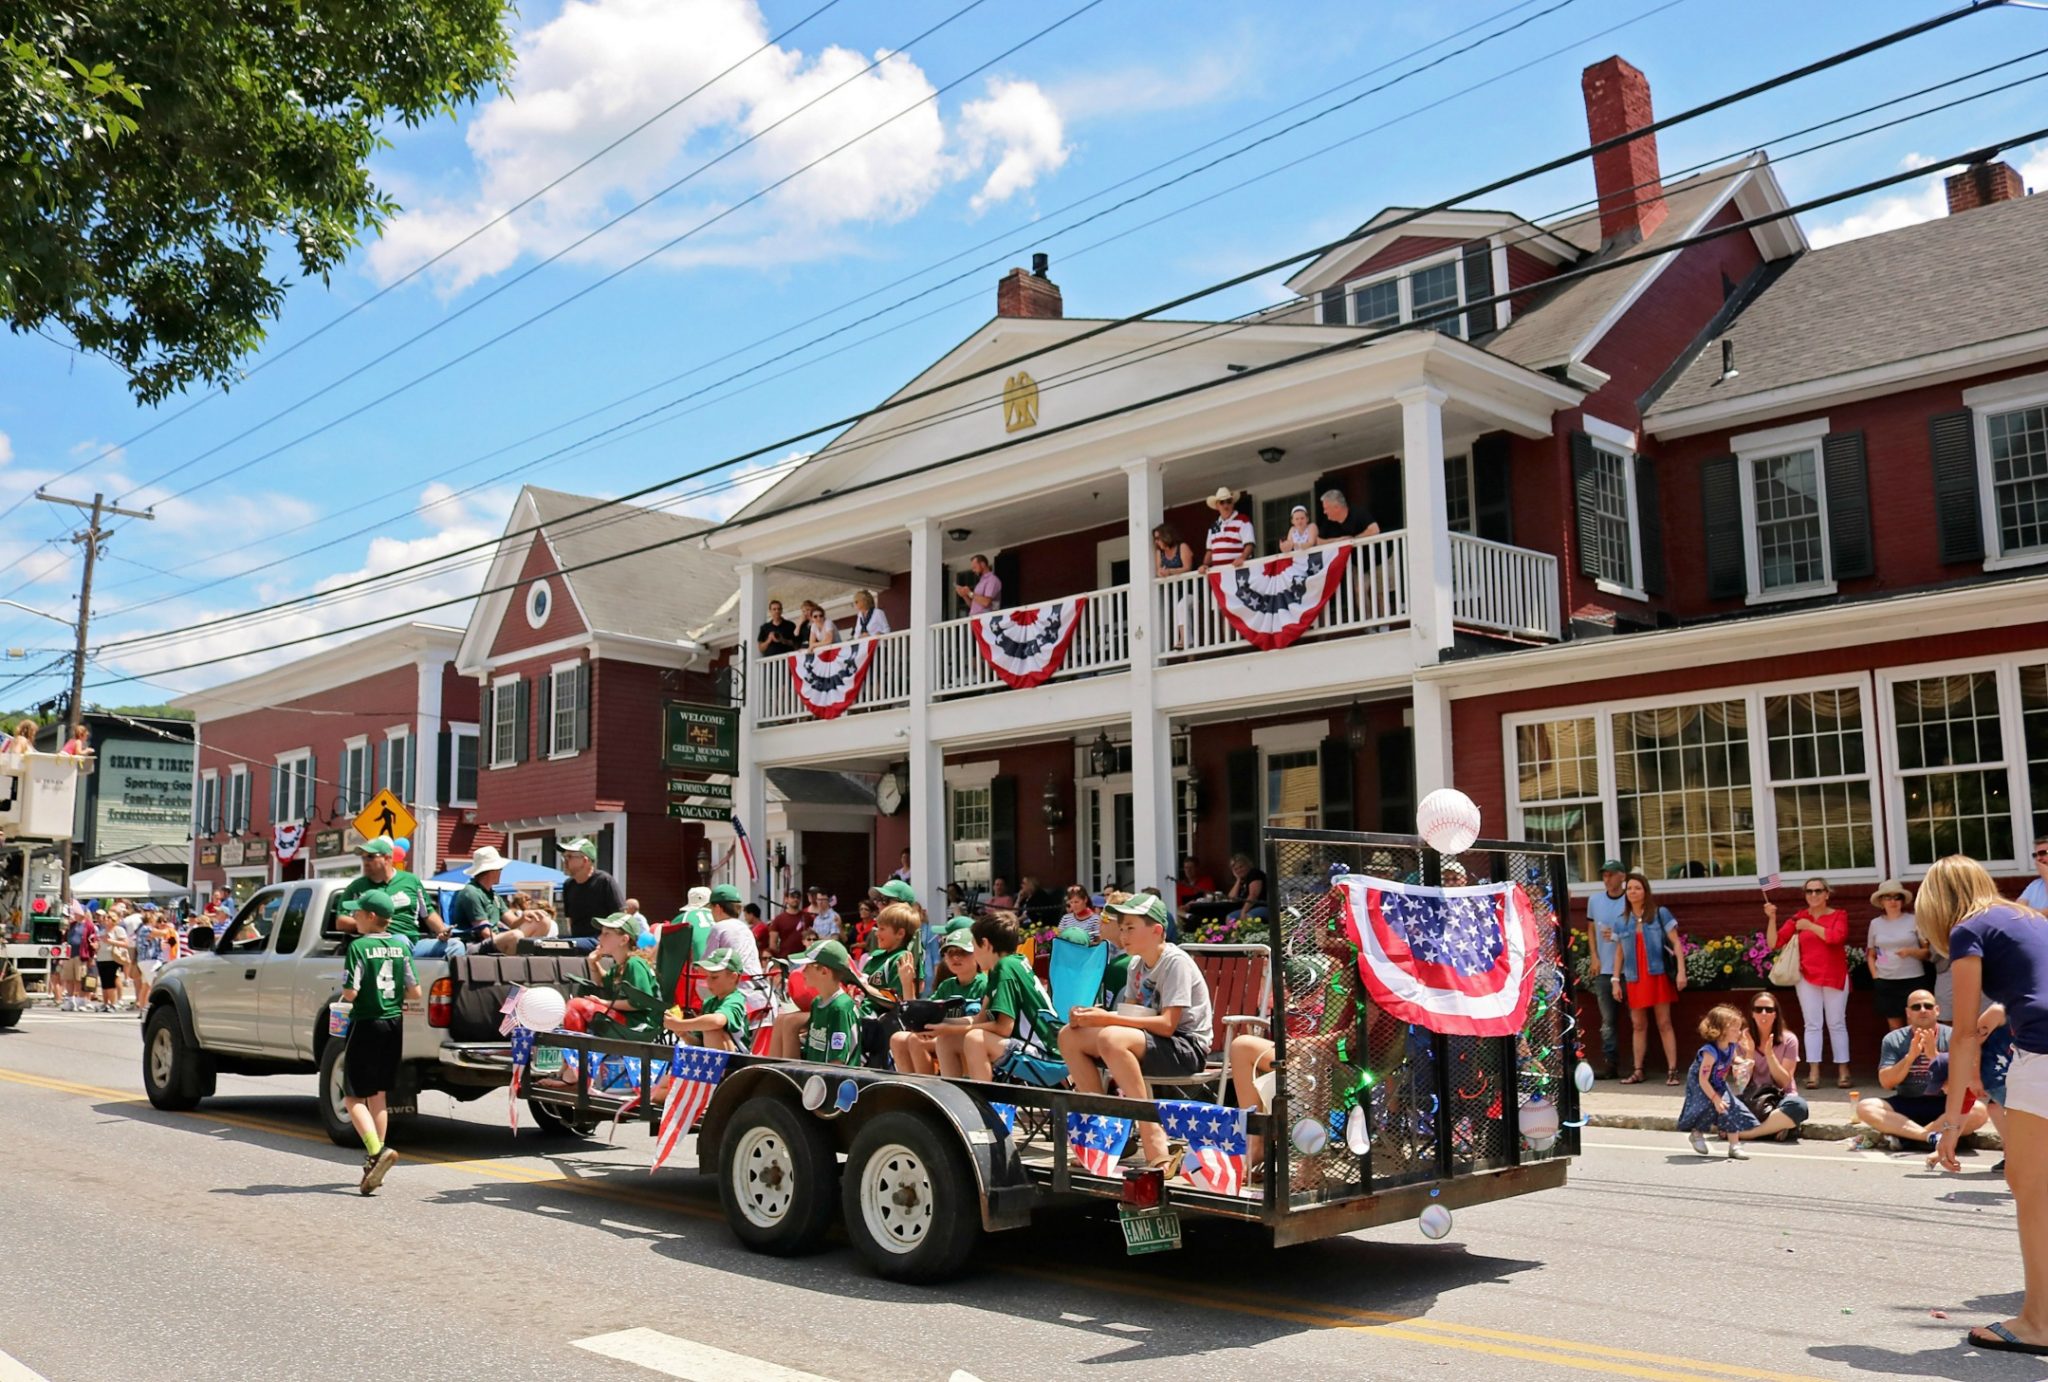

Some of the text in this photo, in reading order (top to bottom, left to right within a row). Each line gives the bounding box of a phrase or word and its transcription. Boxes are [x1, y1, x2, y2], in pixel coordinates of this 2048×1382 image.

[680, 711, 725, 725] WELCOME
[672, 745, 695, 754] GREEN
[697, 746, 730, 758] MOUNTAIN
[110, 756, 152, 769] SHAW'S
[695, 754, 708, 763] INN
[125, 777, 168, 791] Sporting
[672, 783, 729, 796] SWIMMING POOL
[124, 793, 155, 806] Family
[376, 959, 396, 999] 4
[1130, 1216, 1178, 1242] AMH 841
